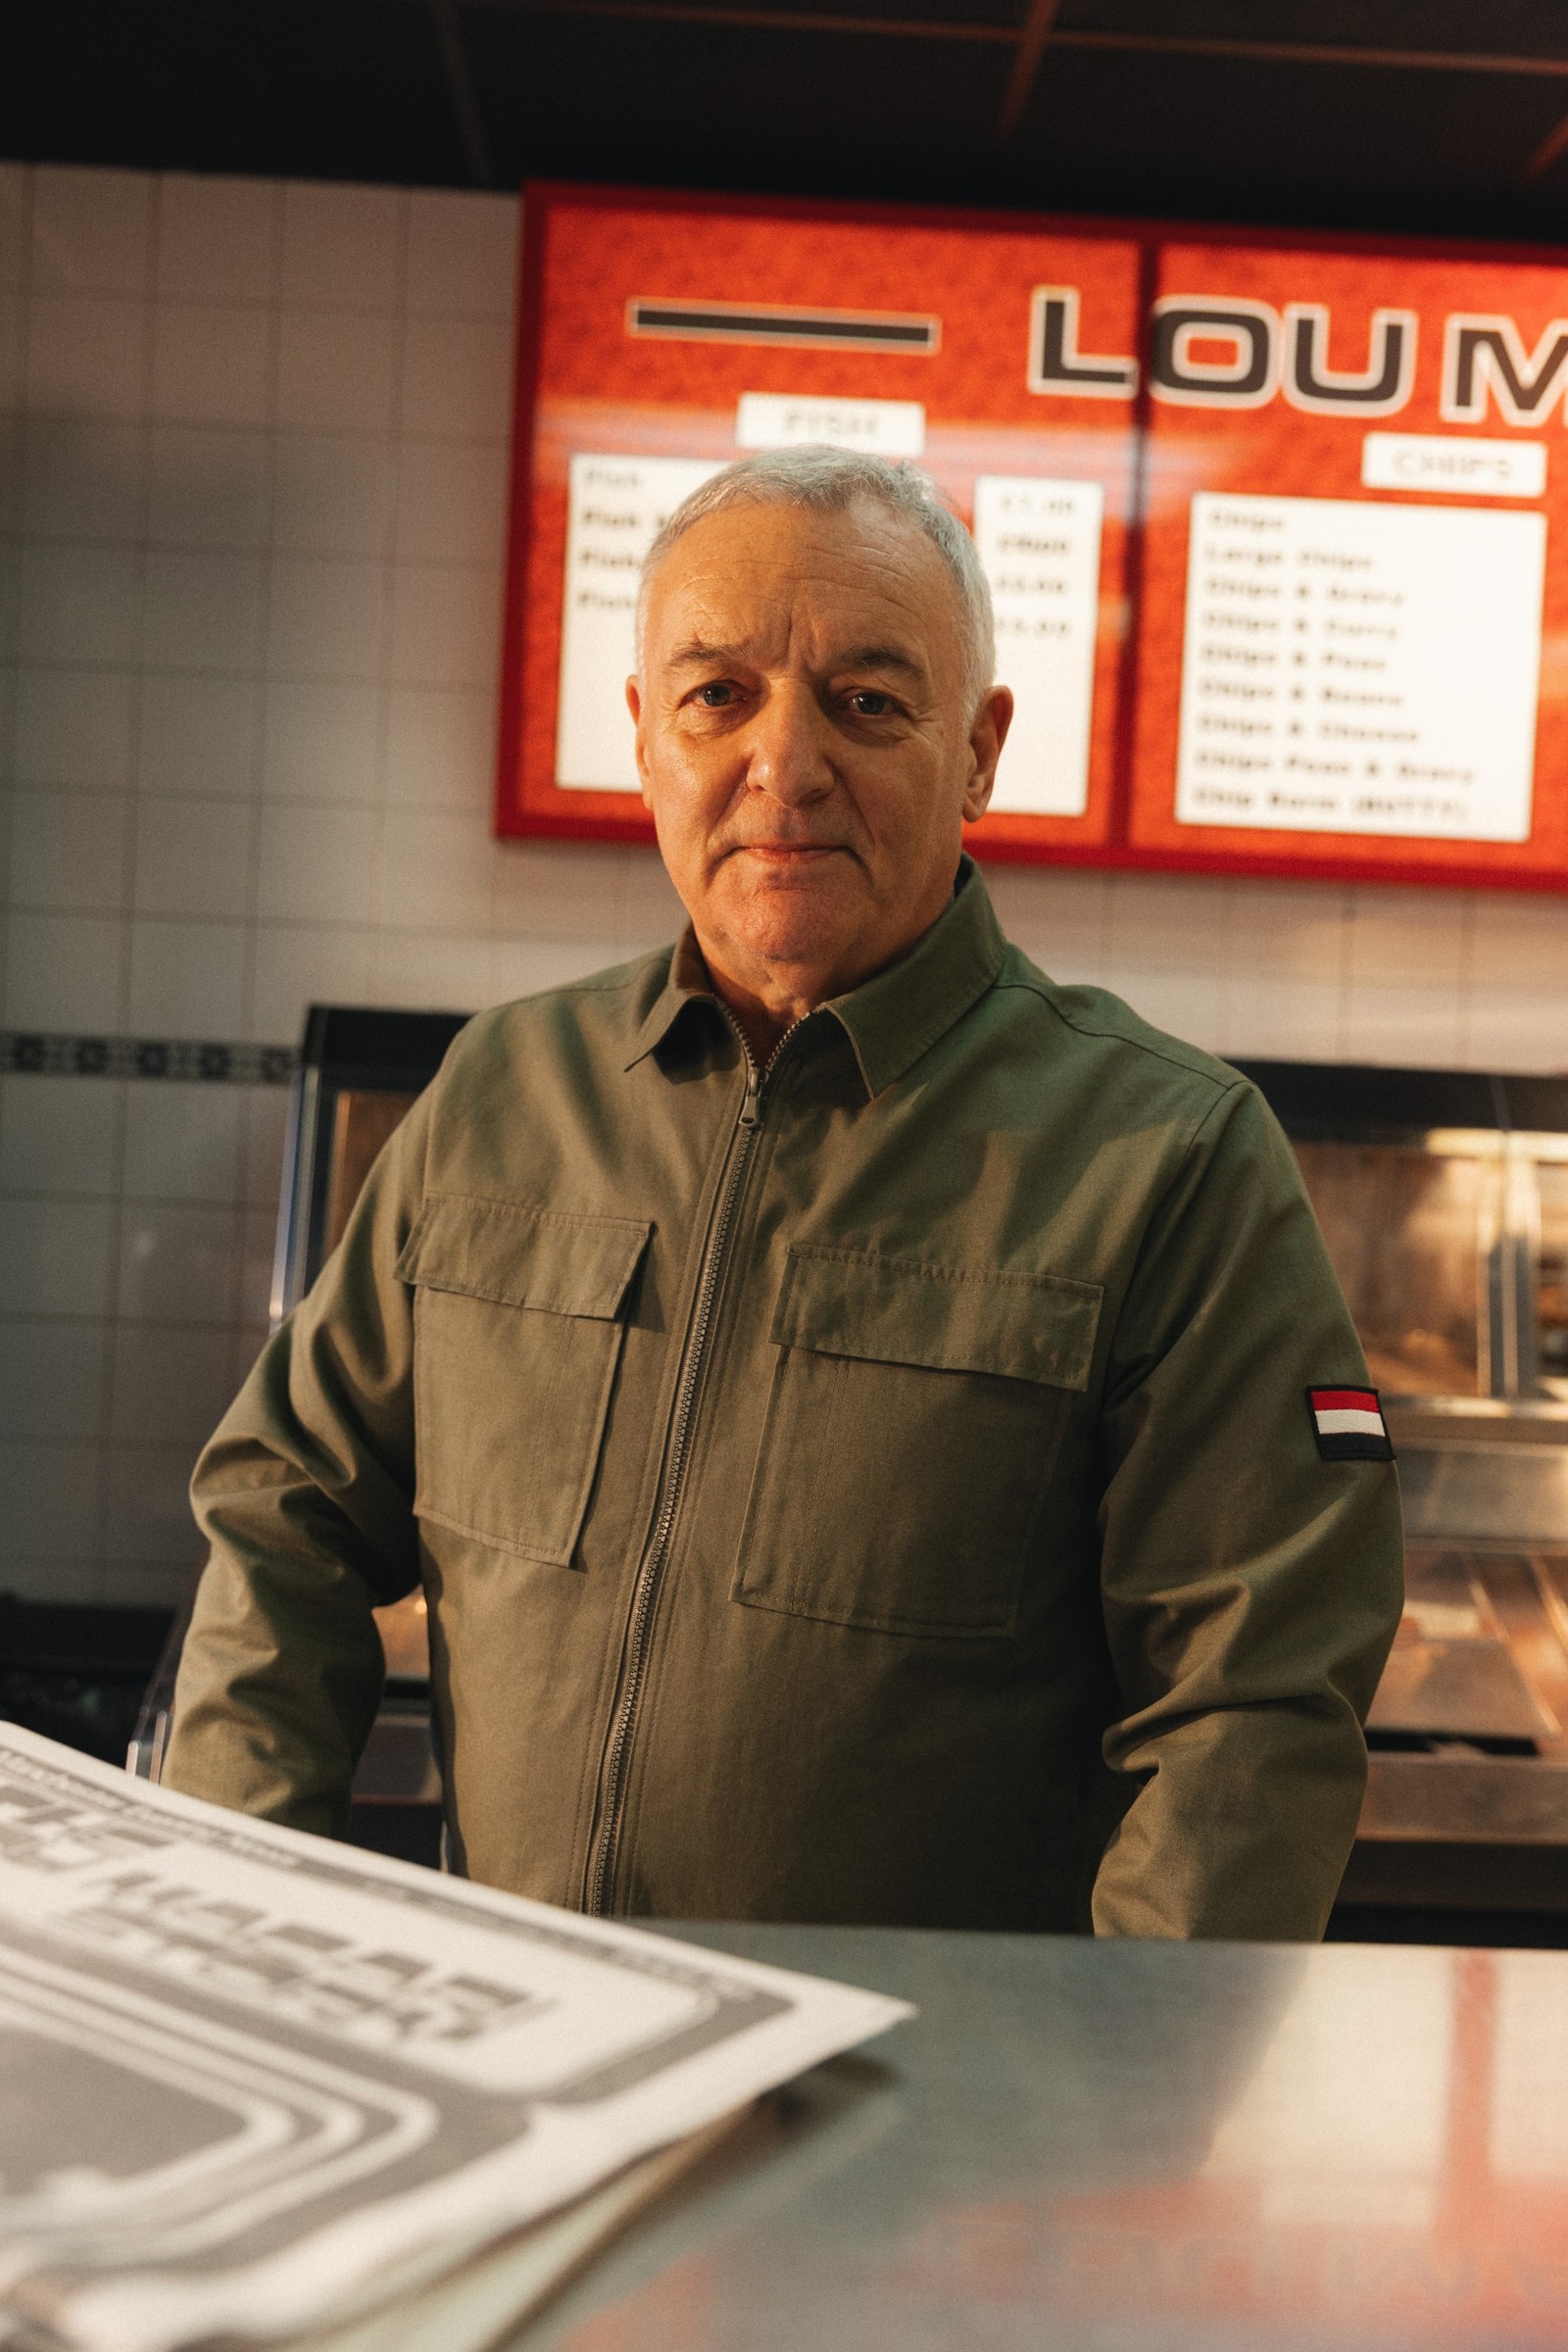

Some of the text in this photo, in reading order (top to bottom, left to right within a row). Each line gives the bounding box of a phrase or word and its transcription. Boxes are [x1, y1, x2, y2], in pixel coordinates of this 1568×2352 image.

[1028, 284, 1418, 417] LOU
[785, 412, 877, 439] FISH
[1395, 448, 1511, 481] CHIPS
[1210, 510, 1286, 531] Chips
[1207, 544, 1374, 570] Large Chips
[1206, 577, 1281, 598] Chips
[1327, 584, 1405, 608] Gravy
[1204, 611, 1280, 632] Chips
[1203, 644, 1278, 665] Chips
[1201, 679, 1276, 700] Chips
[1200, 714, 1274, 735] Chips
[1319, 721, 1421, 744] Cheese
[1198, 751, 1272, 771] Chips
